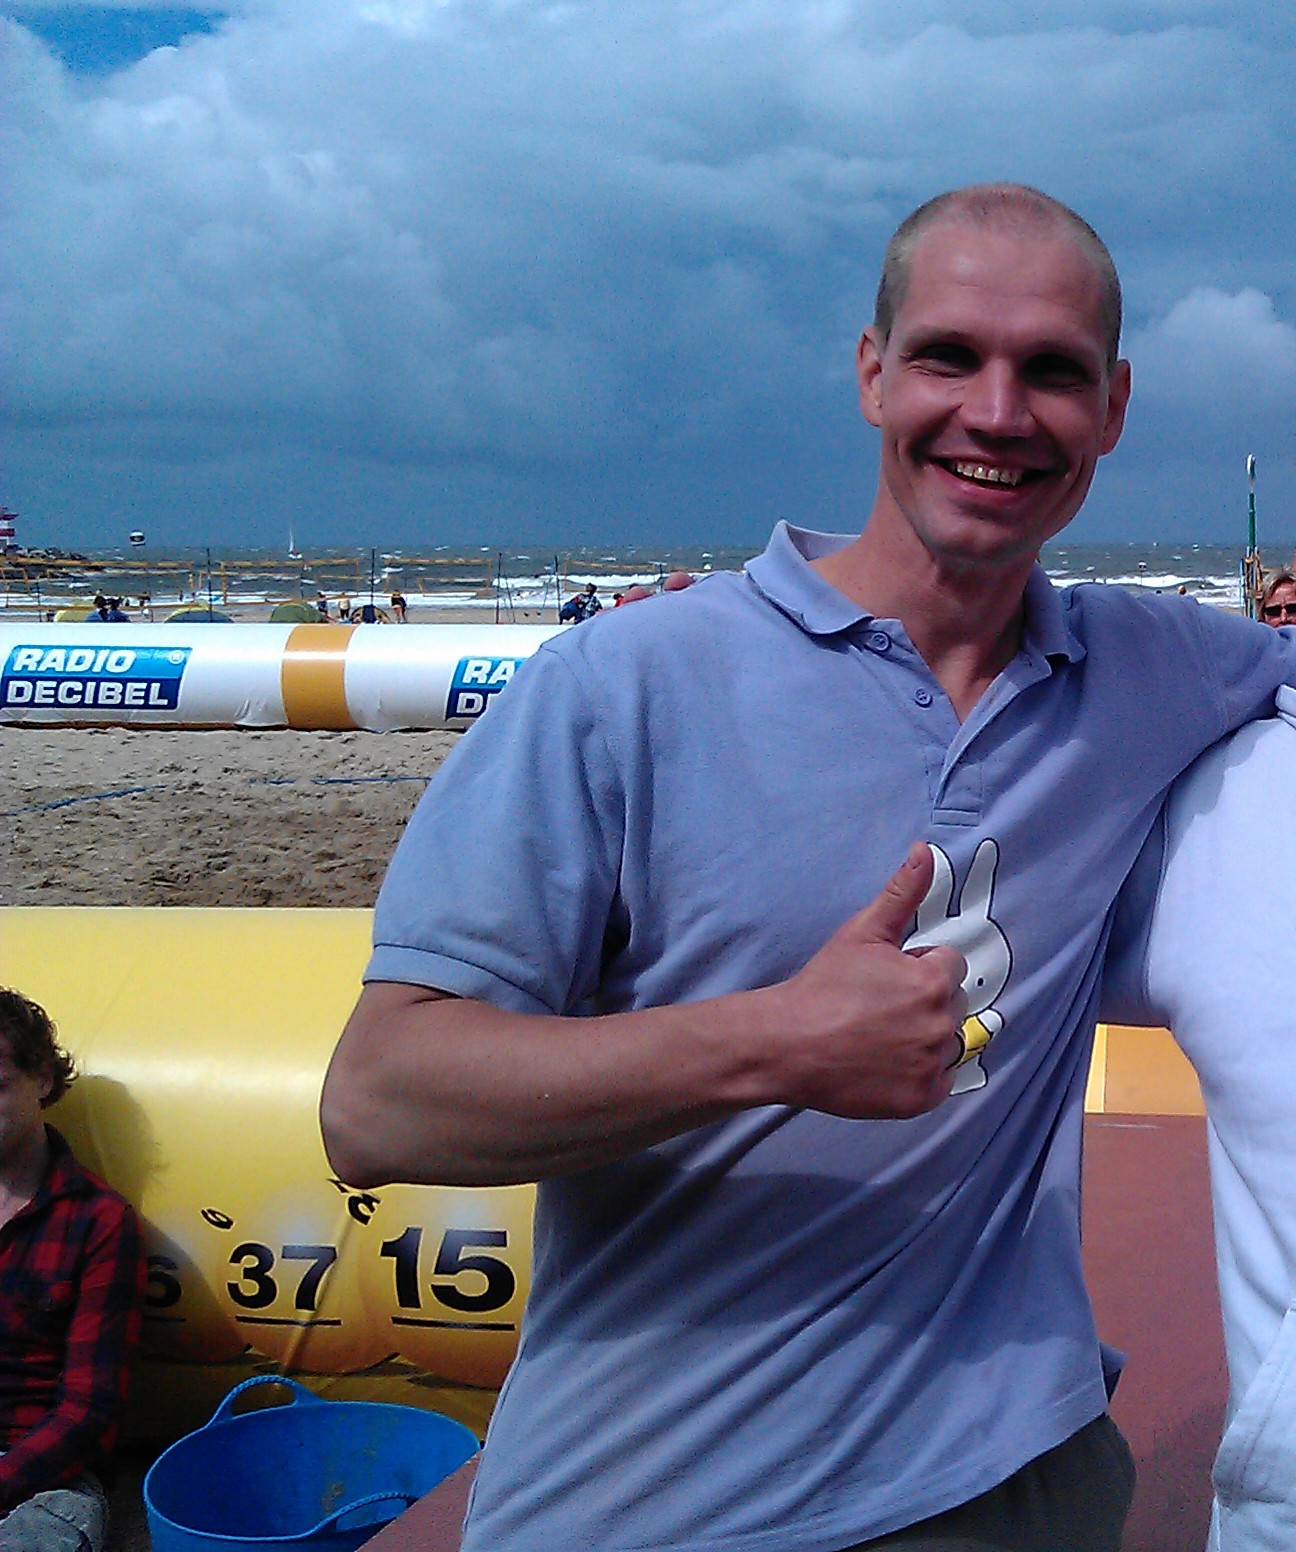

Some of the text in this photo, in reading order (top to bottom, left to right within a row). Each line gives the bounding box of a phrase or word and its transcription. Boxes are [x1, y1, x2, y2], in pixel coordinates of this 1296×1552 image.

[13, 648, 137, 673] RADIO
[6, 680, 169, 706] DECIBEL
[226, 1242, 338, 1311] 37
[380, 1227, 516, 1312] 15
